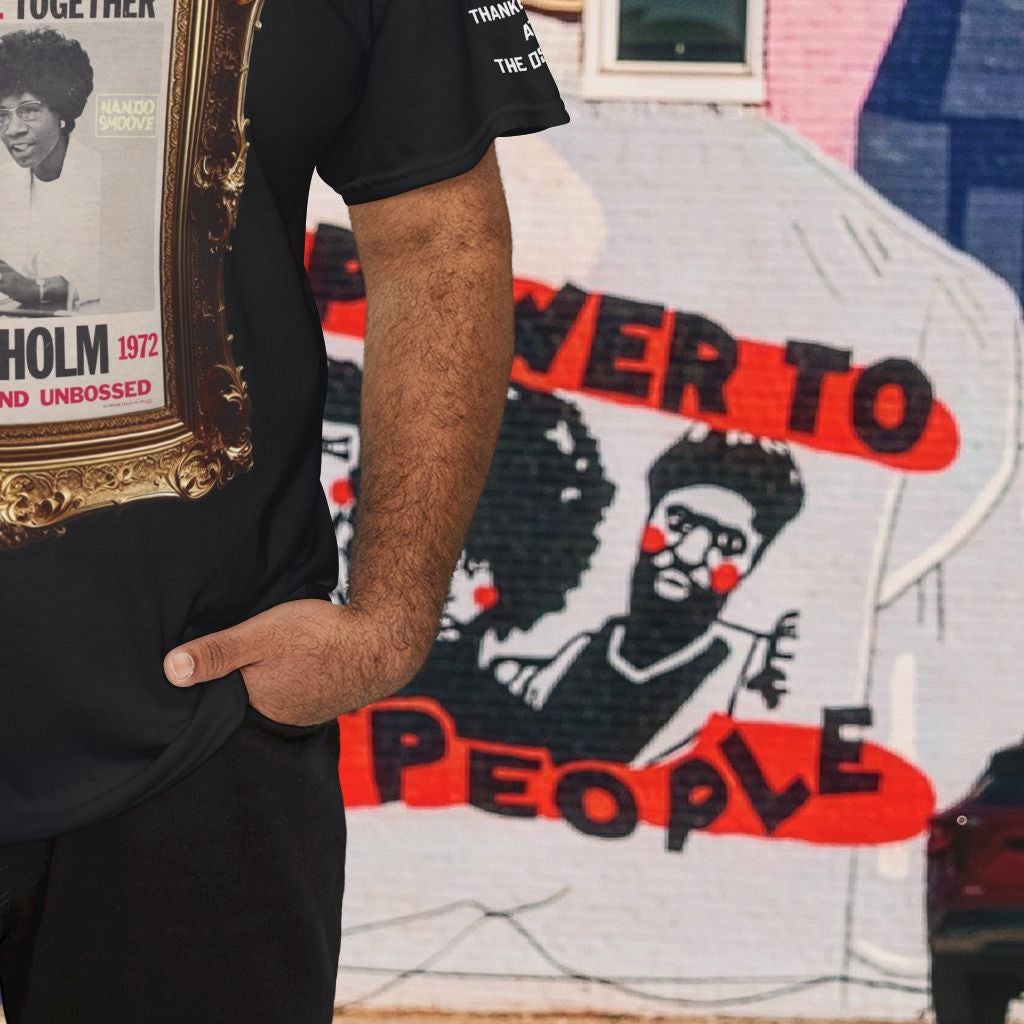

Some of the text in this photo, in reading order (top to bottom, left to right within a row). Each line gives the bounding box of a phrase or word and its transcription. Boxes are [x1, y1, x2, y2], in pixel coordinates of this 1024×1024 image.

[493, 56, 528, 74] THE
[118, 333, 159, 361] 1972
[310, 223, 933, 455] PWER TO
[40, 379, 152, 407] UNBOSSED
[371, 706, 883, 853] PEOPLE
